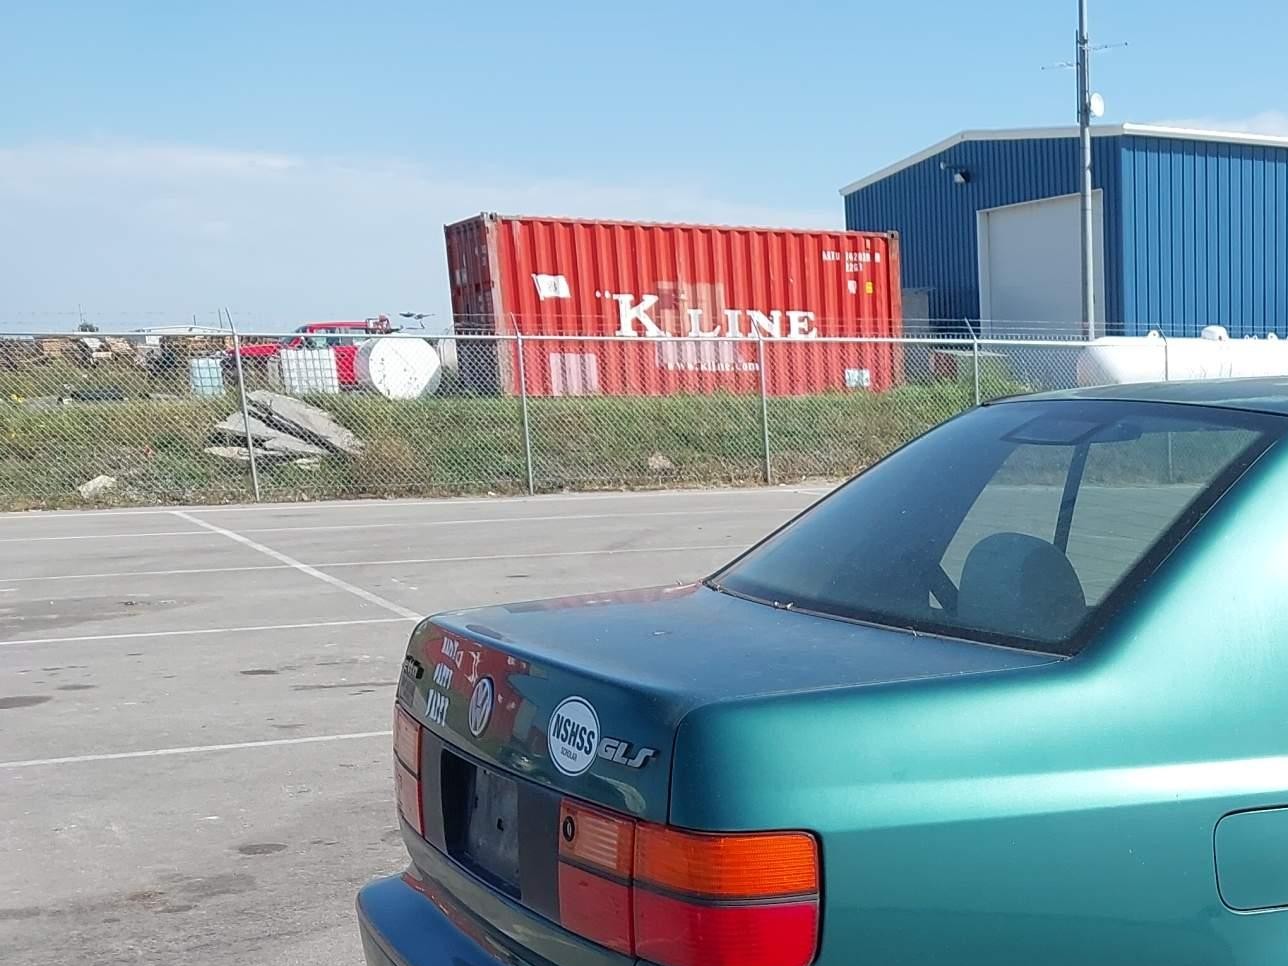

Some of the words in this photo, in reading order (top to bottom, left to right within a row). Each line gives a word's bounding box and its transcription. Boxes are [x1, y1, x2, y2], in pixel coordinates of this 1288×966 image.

[687, 309, 819, 338] LINE
[552, 713, 596, 755] NSHSS
[560, 746, 578, 762] SCHOLAR
[598, 737, 657, 768] GLS
